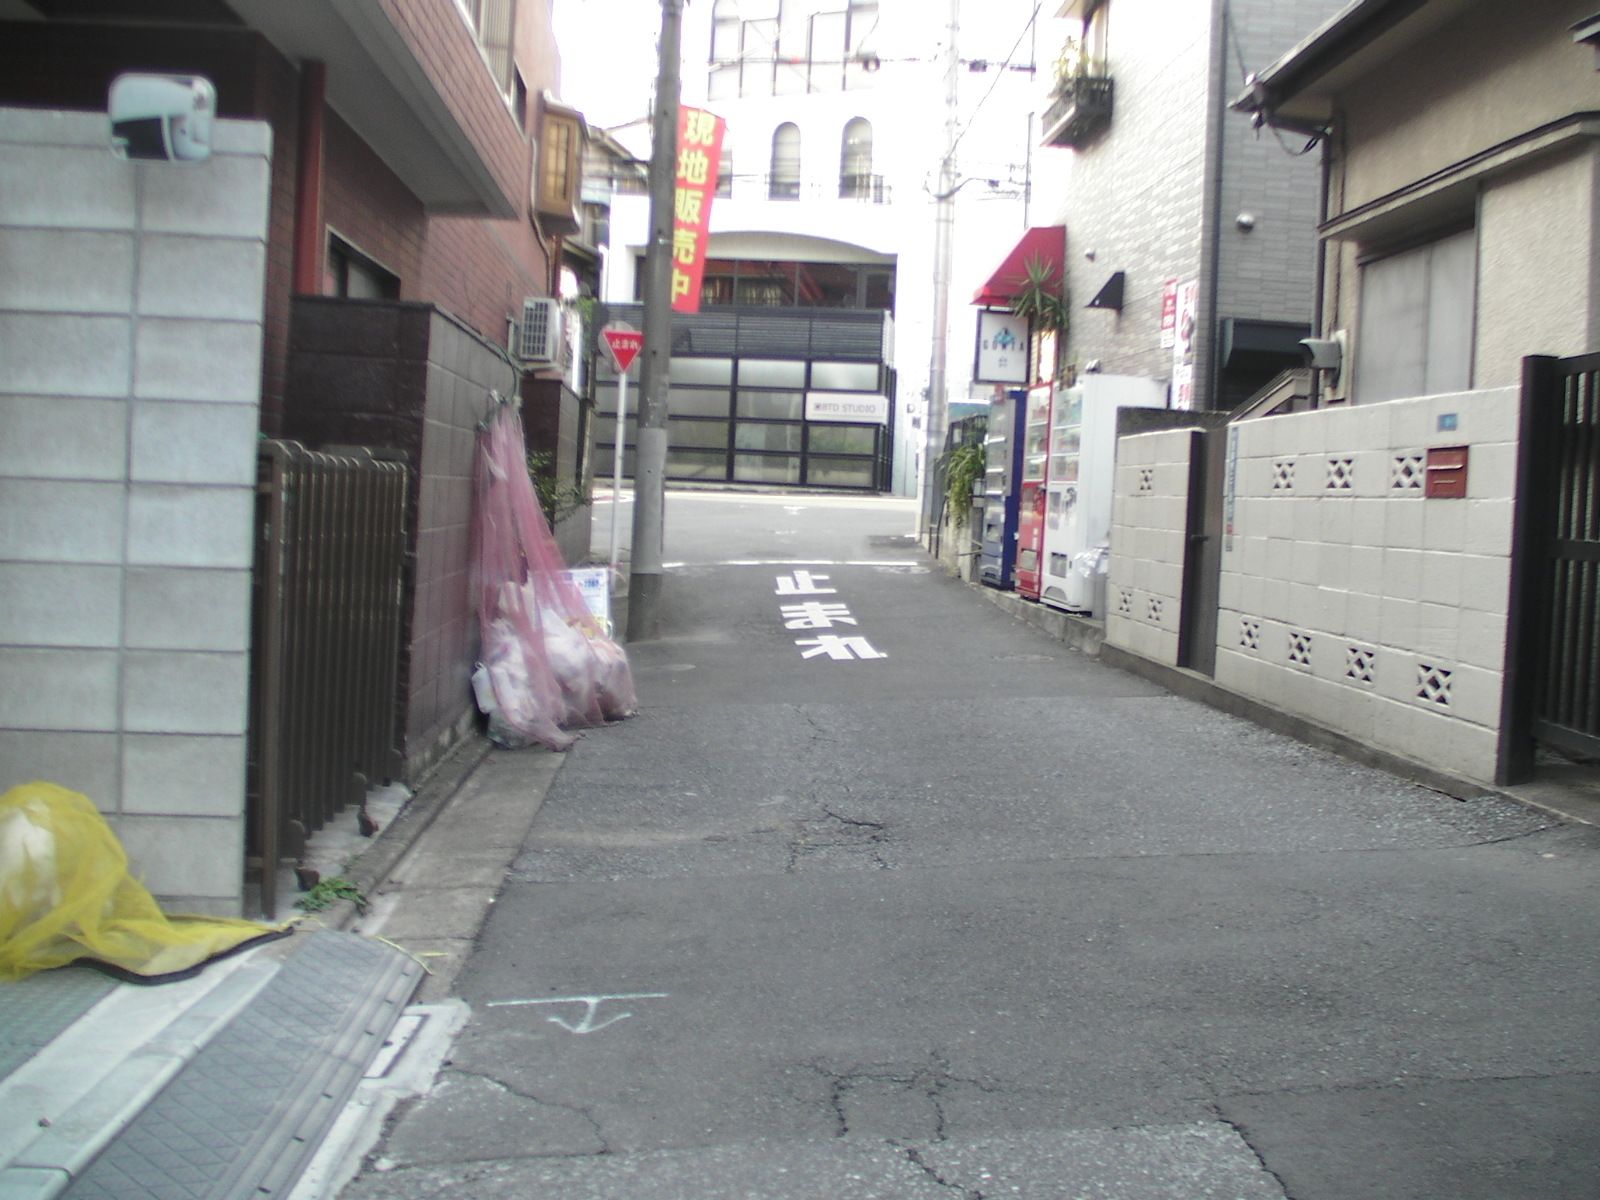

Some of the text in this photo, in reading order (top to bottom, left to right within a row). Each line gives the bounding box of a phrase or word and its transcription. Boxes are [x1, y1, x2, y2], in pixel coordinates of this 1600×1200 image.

[671, 110, 717, 304] 現地販売中
[612, 337, 638, 350] 止まれ
[842, 403, 876, 413] STUDIO
[774, 570, 889, 660] 止まれ
